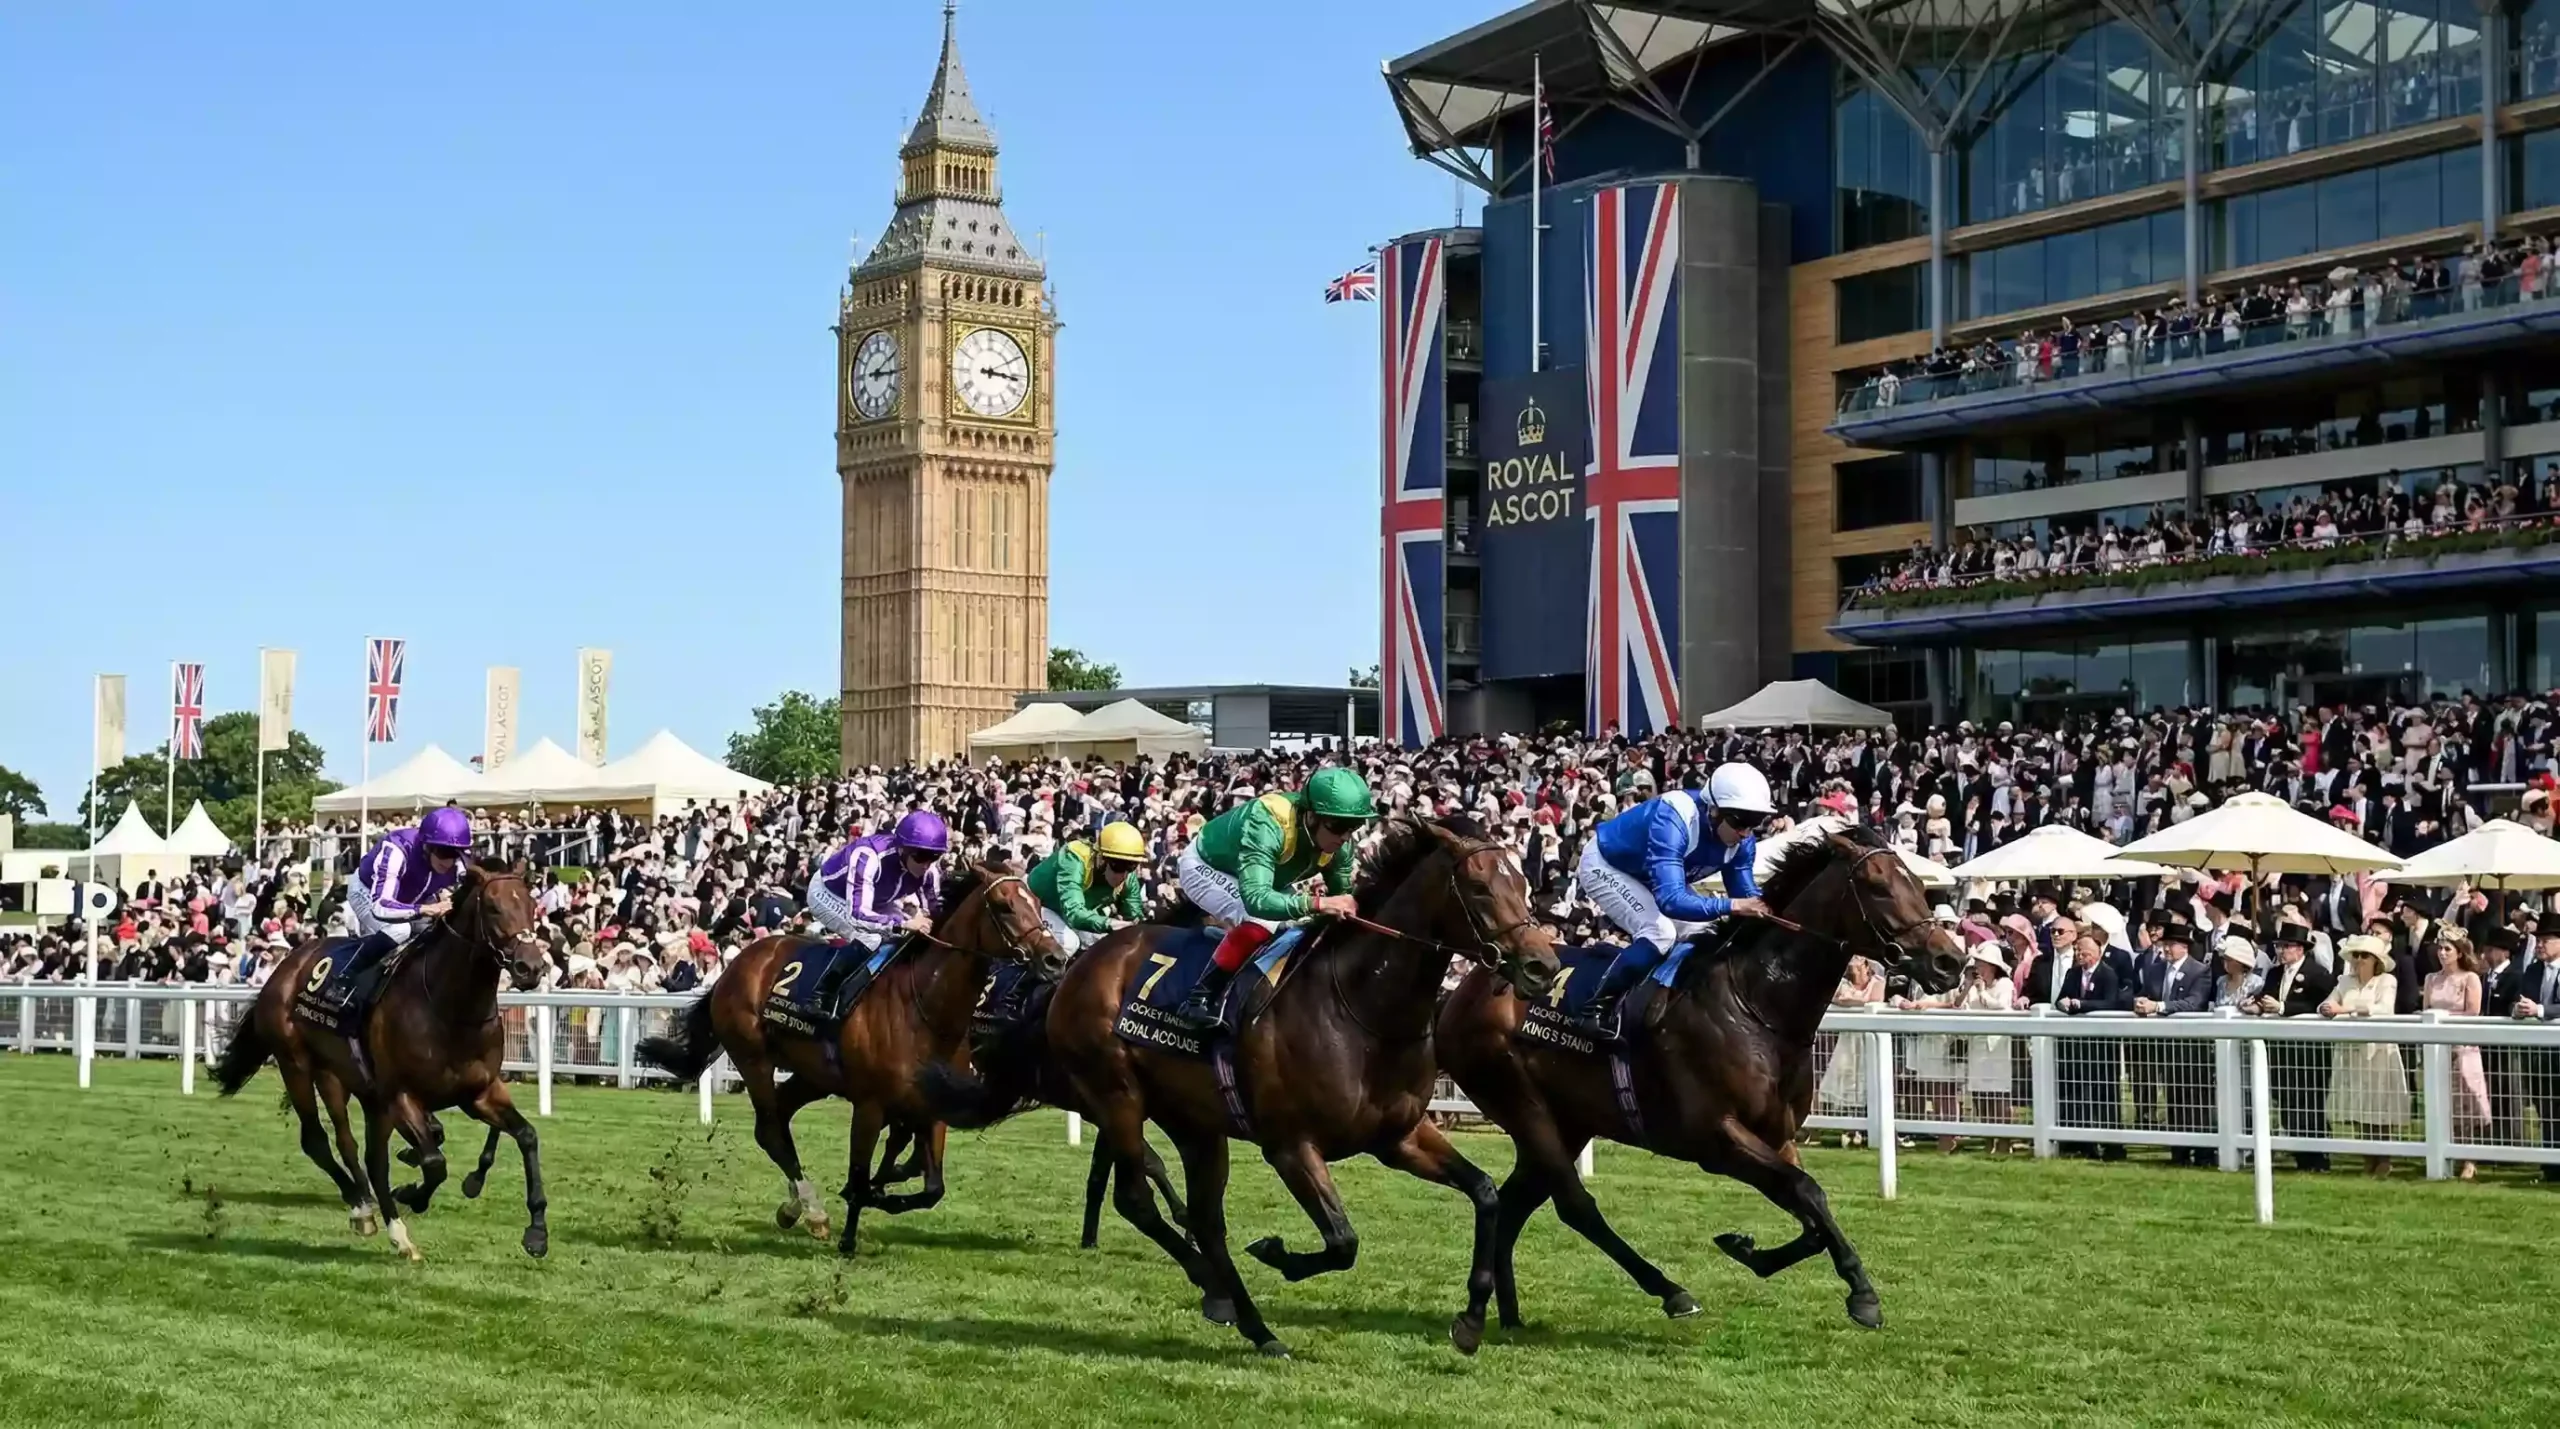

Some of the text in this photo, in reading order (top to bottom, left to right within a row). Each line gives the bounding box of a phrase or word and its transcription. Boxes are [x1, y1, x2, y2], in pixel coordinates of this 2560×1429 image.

[1487, 450, 1575, 491] ROYAL
[1486, 487, 1575, 528] ASCOT
[589, 655, 605, 705] ASCOT
[306, 956, 333, 992] 9
[772, 961, 803, 997] 2
[1137, 952, 1178, 1001] 7
[1546, 966, 1576, 1008] 4
[1119, 1017, 1149, 1039] ROYAL
[1560, 1032, 1594, 1054] STAND
